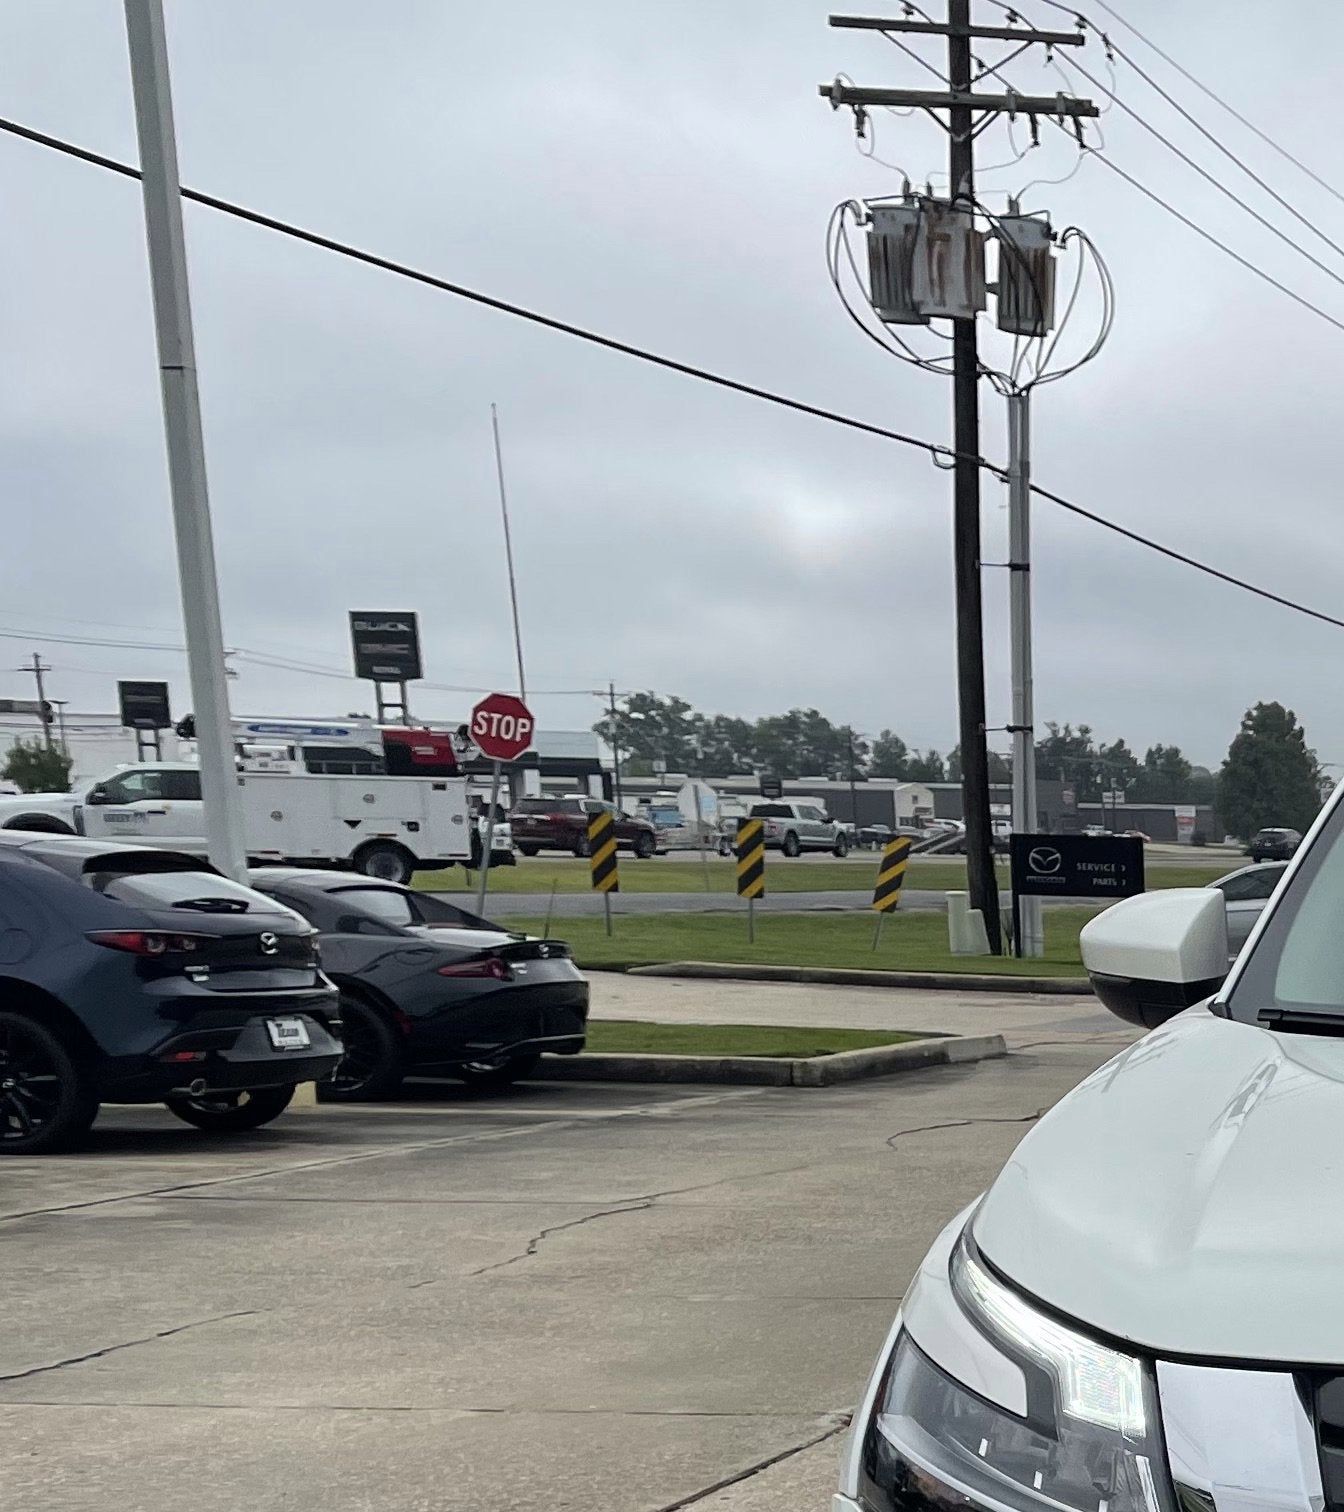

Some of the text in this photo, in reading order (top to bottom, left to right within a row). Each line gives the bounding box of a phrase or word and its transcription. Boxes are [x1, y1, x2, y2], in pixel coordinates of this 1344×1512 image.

[473, 710, 531, 742] STOP
[1076, 862, 1116, 872] SERVICE
[1093, 877, 1118, 886] PARTS
